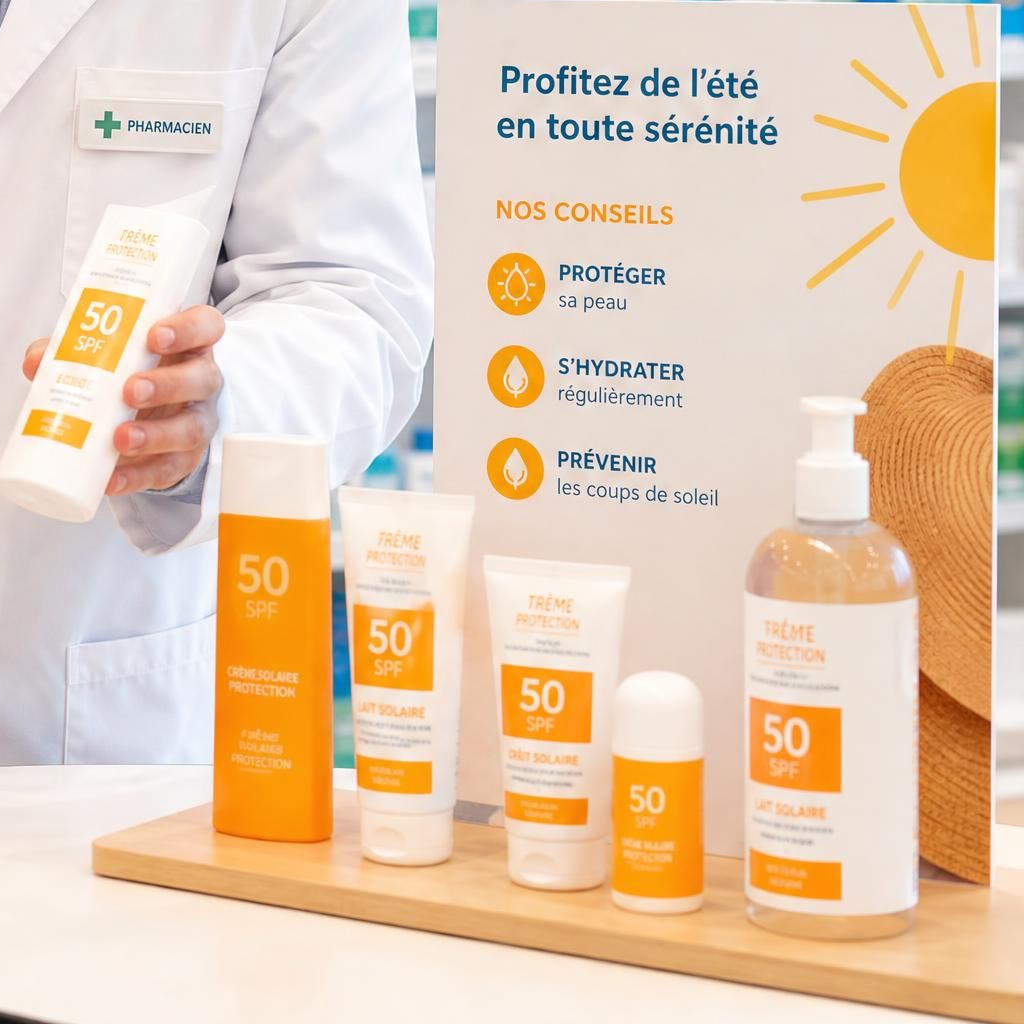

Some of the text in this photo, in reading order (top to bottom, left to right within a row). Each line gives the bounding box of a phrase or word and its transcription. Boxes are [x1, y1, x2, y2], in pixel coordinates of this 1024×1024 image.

[501, 65, 629, 96] Profitez
[640, 67, 680, 97] de
[127, 119, 211, 135] PHARMACIEN
[497, 114, 778, 145] en toute sérénité
[496, 199, 674, 225] NOS CONSEILS
[559, 262, 666, 286] PROTÉGER
[559, 294, 627, 312] sa peau
[80, 301, 123, 336] 50
[74, 336, 105, 354] SPF
[558, 385, 683, 408] régulièrement
[557, 449, 657, 474] PRÉVENIR
[557, 478, 719, 506] les coups de soleil
[237, 553, 291, 596] 50
[245, 599, 280, 620] SPF
[367, 618, 413, 656] 50
[374, 658, 404, 678] SPF
[228, 680, 296, 698] PROTECTION
[519, 677, 566, 714] 50
[379, 704, 425, 719] SOLAIRE
[526, 716, 556, 734] SPF
[762, 713, 811, 758] 50
[769, 758, 801, 780] SPF
[629, 784, 666, 815] 50
